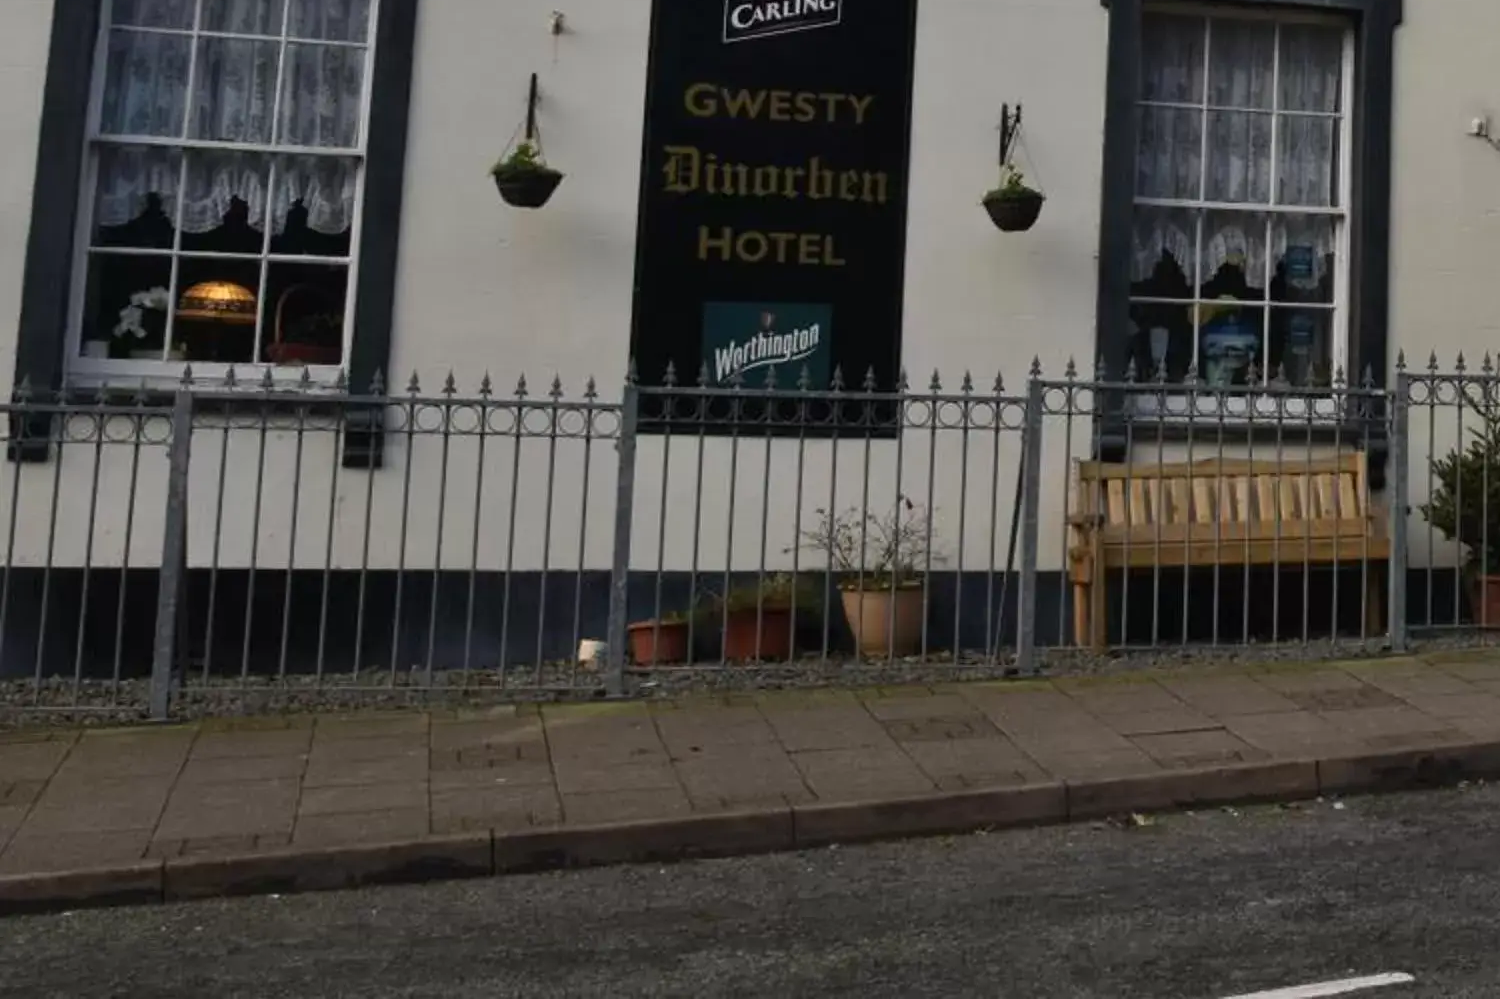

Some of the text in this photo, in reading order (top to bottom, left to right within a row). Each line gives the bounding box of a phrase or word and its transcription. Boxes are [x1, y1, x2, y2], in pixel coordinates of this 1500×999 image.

[684, 82, 875, 124] GWESTY
[662, 146, 888, 205] Dinorben
[697, 226, 846, 267] HOTEL
[714, 321, 820, 383] Worthington
